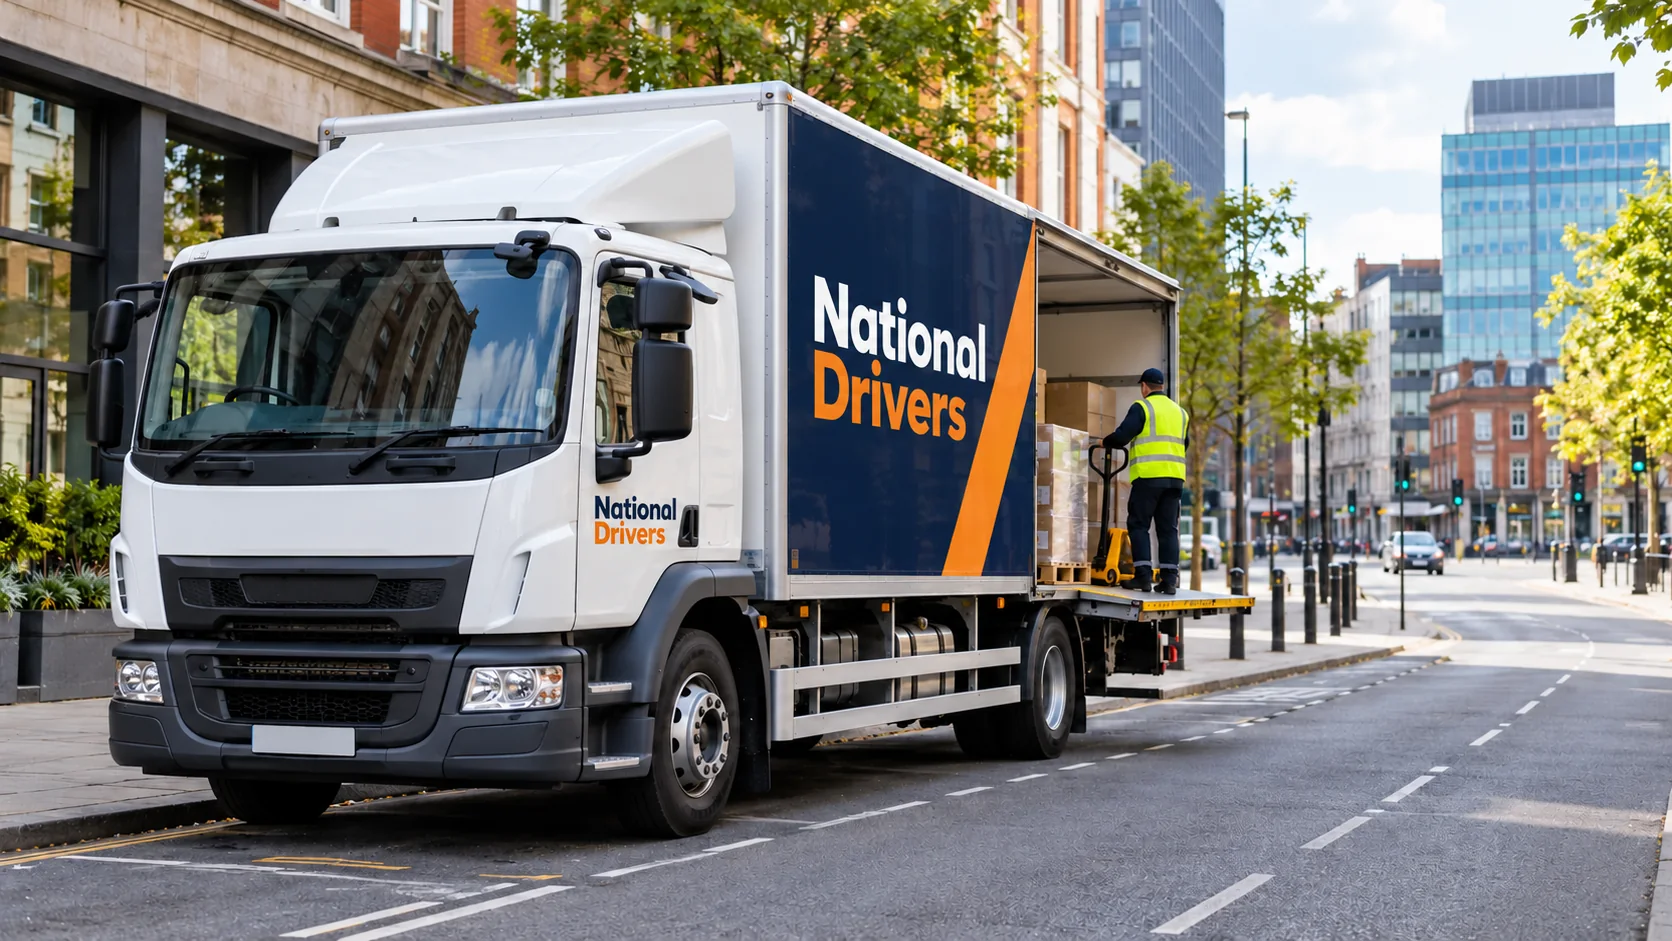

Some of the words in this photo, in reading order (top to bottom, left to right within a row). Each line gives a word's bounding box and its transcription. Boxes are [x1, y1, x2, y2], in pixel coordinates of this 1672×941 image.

[814, 274, 986, 383] National
[814, 349, 967, 442] Drivers
[594, 495, 677, 520] National
[594, 520, 666, 545] Drivers
